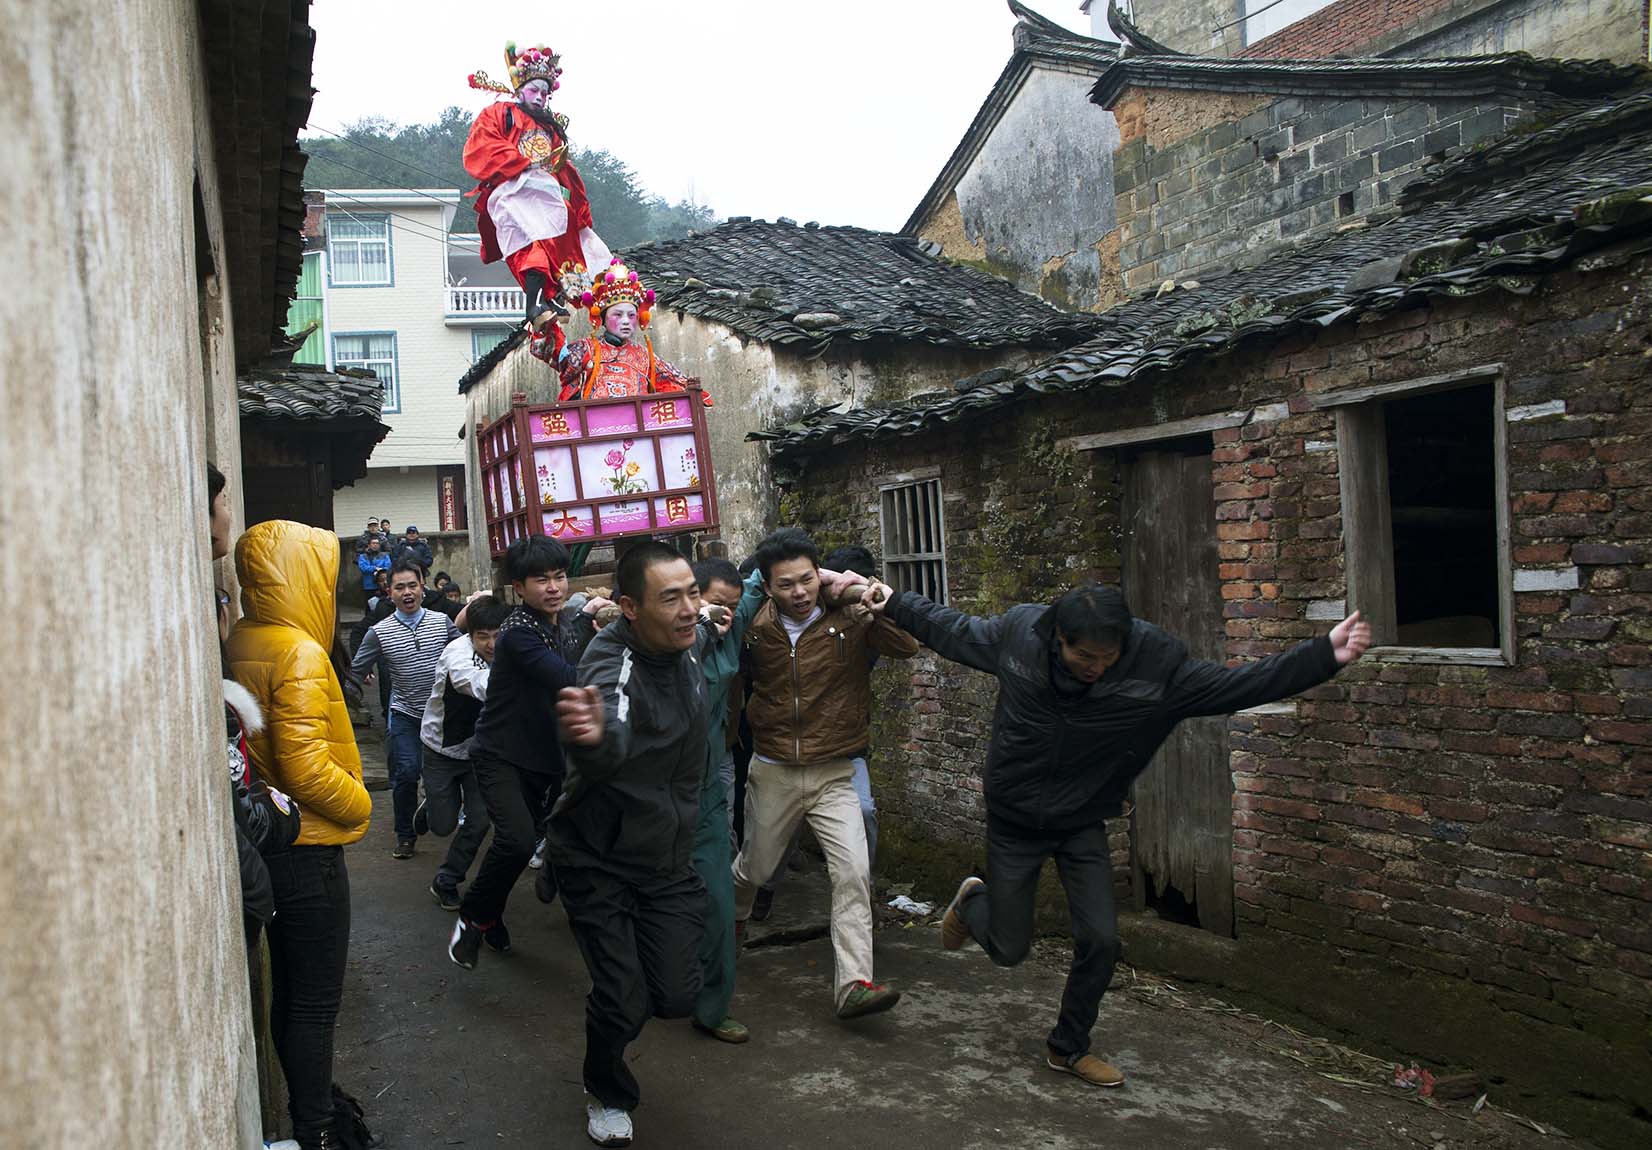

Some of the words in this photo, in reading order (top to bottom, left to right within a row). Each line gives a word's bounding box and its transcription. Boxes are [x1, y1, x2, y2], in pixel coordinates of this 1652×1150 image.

[540, 411, 570, 436] 强
[650, 400, 679, 425] 祖
[666, 495, 689, 524] 国
[552, 510, 585, 538] 大
